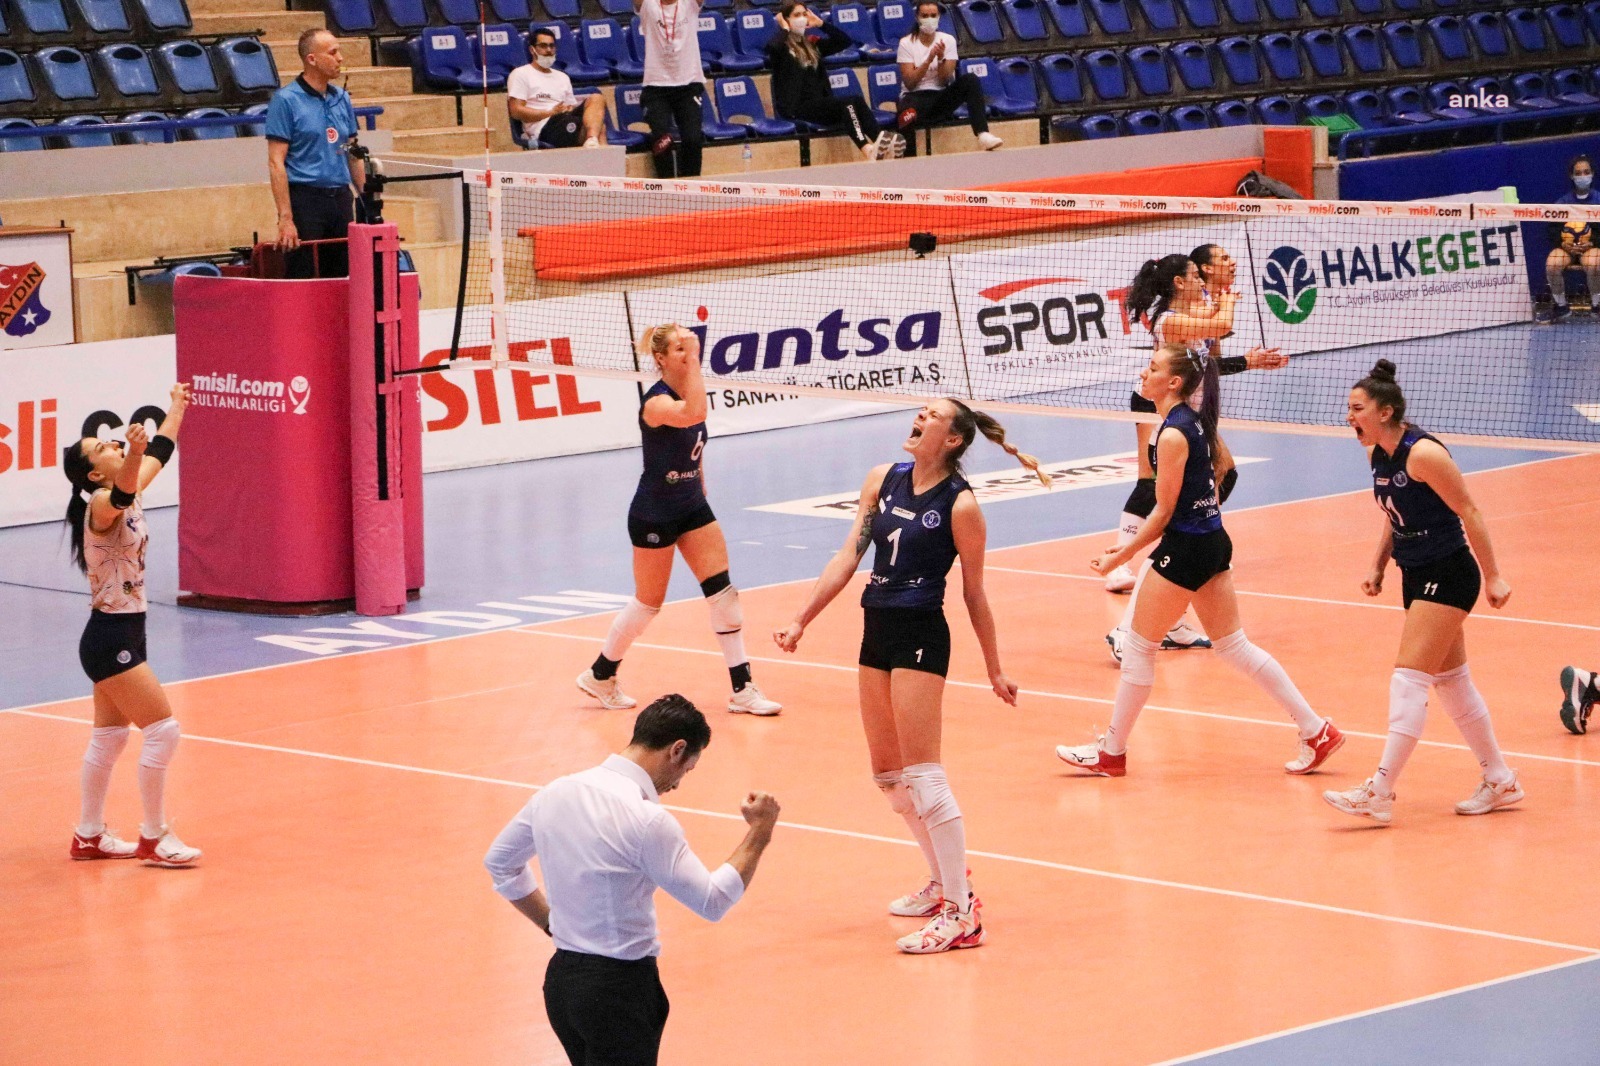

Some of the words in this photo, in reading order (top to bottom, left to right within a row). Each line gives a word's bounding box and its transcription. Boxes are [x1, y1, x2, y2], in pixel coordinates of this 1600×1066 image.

[549, 177, 587, 188] misli.com
[624, 180, 662, 191] misli.com
[700, 184, 740, 195] misli.com
[752, 187, 766, 195] TVF
[779, 188, 820, 198] misli.com
[860, 191, 903, 201] misli.com
[943, 193, 988, 204] misli.com
[1001, 197, 1016, 205] TVF
[1030, 197, 1076, 208] misli.com
[1090, 200, 1105, 208] TVF
[1120, 200, 1166, 210] misli.com
[1181, 202, 1197, 210] TVF
[1212, 202, 1261, 213] misli.com
[1276, 204, 1293, 212] TVF
[1308, 203, 1359, 215] misli.com
[1375, 206, 1392, 215] TVF
[1408, 206, 1461, 217] misli.com
[1478, 208, 1496, 217] TVF
[1513, 208, 1569, 219] misli.com
[1321, 225, 1518, 288] HALKEGEET
[0, 266, 42, 326] AYDIN
[192, 372, 285, 397] misli.com
[828, 366, 905, 391] TİCARET
[691, 431, 705, 460] 6
[887, 528, 903, 566] 1
[1160, 556, 1170, 568] 3
[1424, 582, 1439, 596] 11
[254, 590, 635, 655] AYDIN
[916, 648, 923, 663] 1
